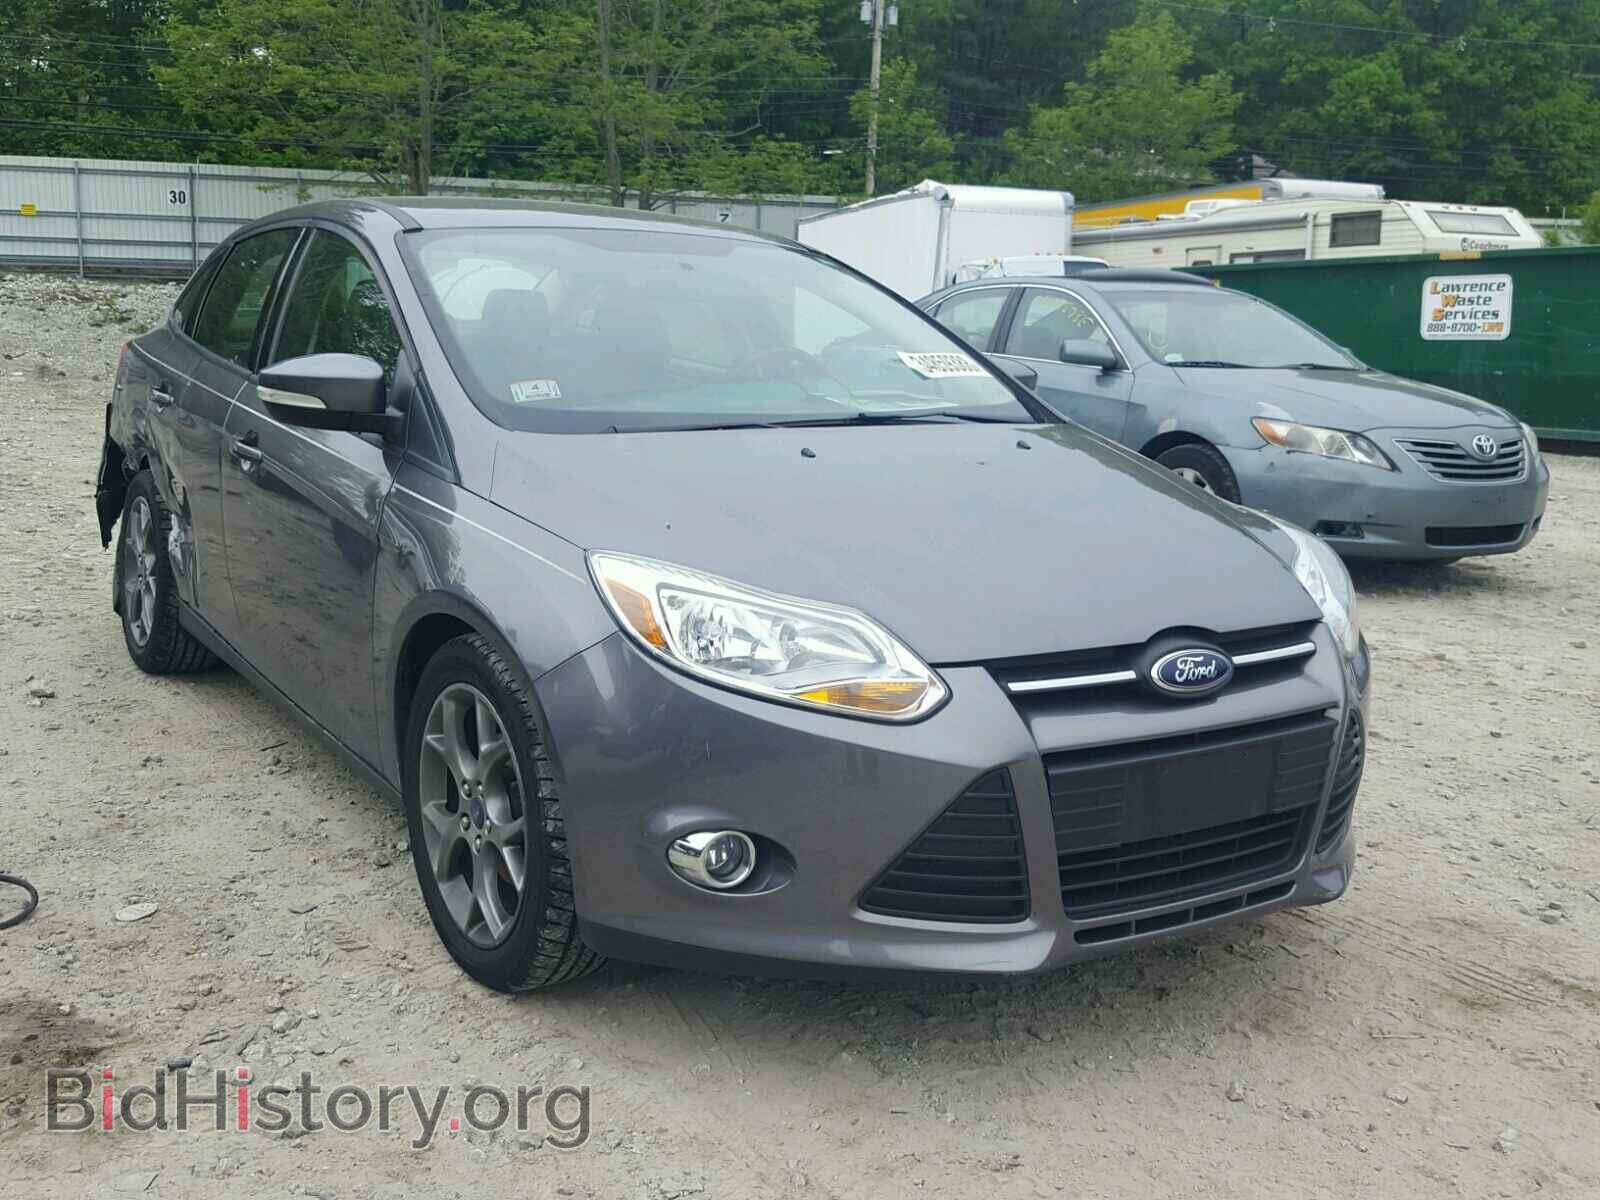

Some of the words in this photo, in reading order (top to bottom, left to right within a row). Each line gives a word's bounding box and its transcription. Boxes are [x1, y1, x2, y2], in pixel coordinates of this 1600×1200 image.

[169, 190, 187, 204] 30
[719, 213, 730, 223] 7
[1430, 281, 1506, 295] Lawrence
[1441, 294, 1492, 308] Waste
[1432, 307, 1500, 321] Services
[1175, 655, 1218, 683] Ford
